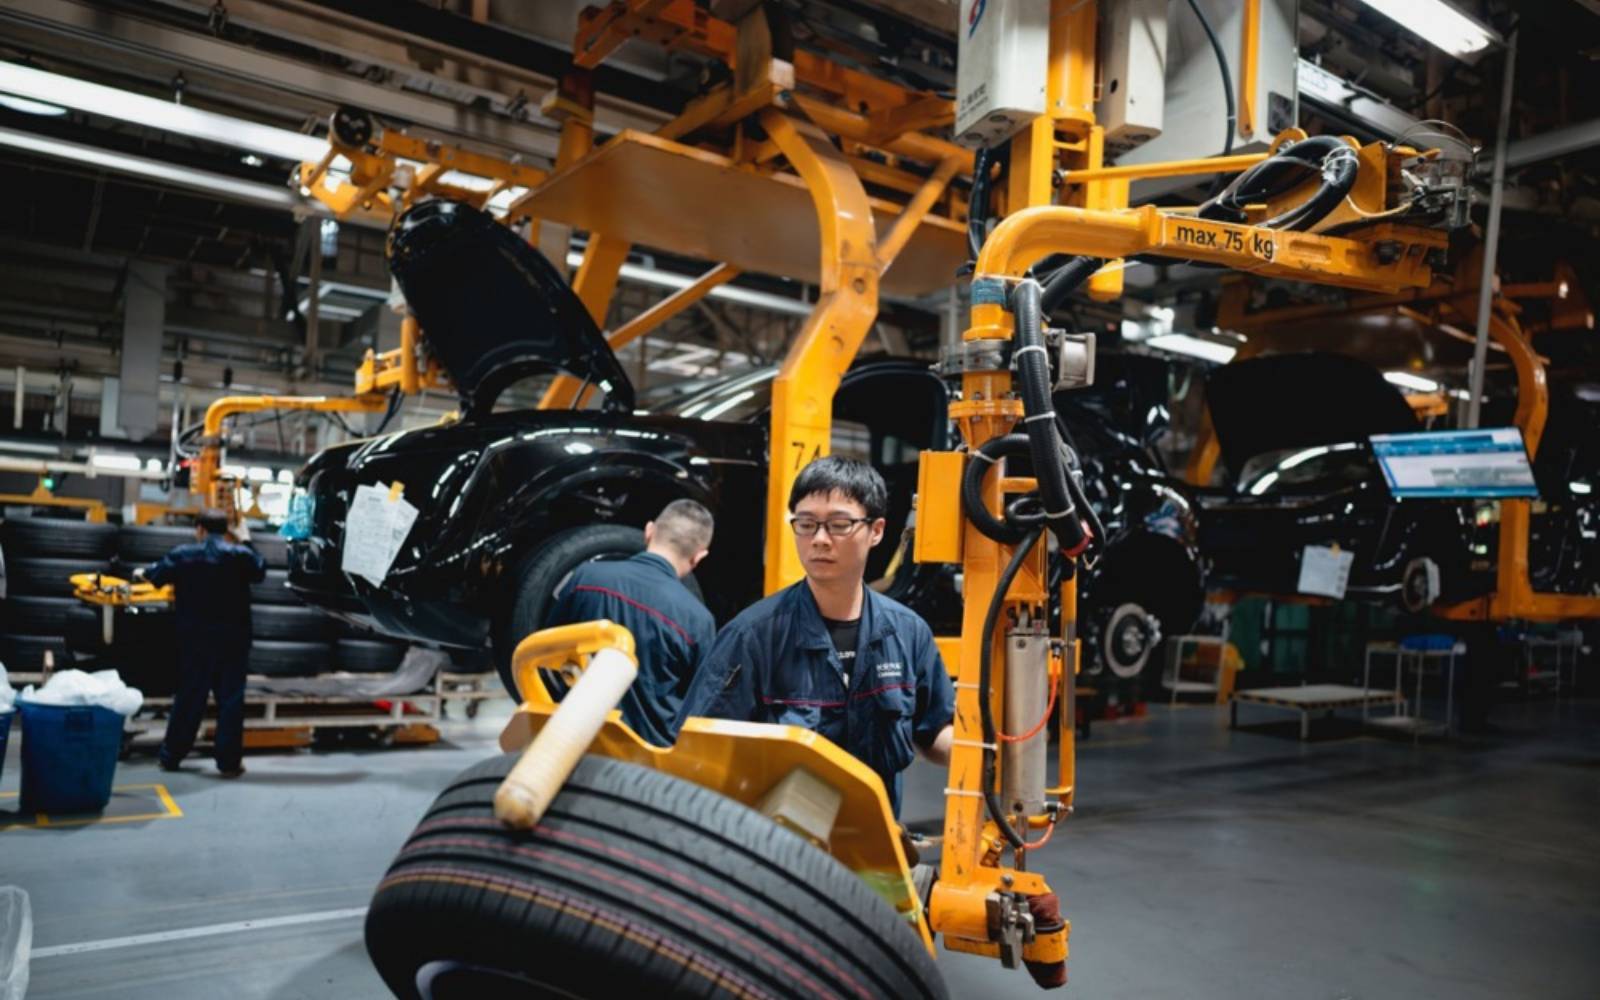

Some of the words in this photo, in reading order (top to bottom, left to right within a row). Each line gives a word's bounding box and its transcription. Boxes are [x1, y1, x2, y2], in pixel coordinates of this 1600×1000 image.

[1177, 225, 1217, 246] max
[1223, 229, 1244, 252] 75
[1253, 233, 1274, 260] kg
